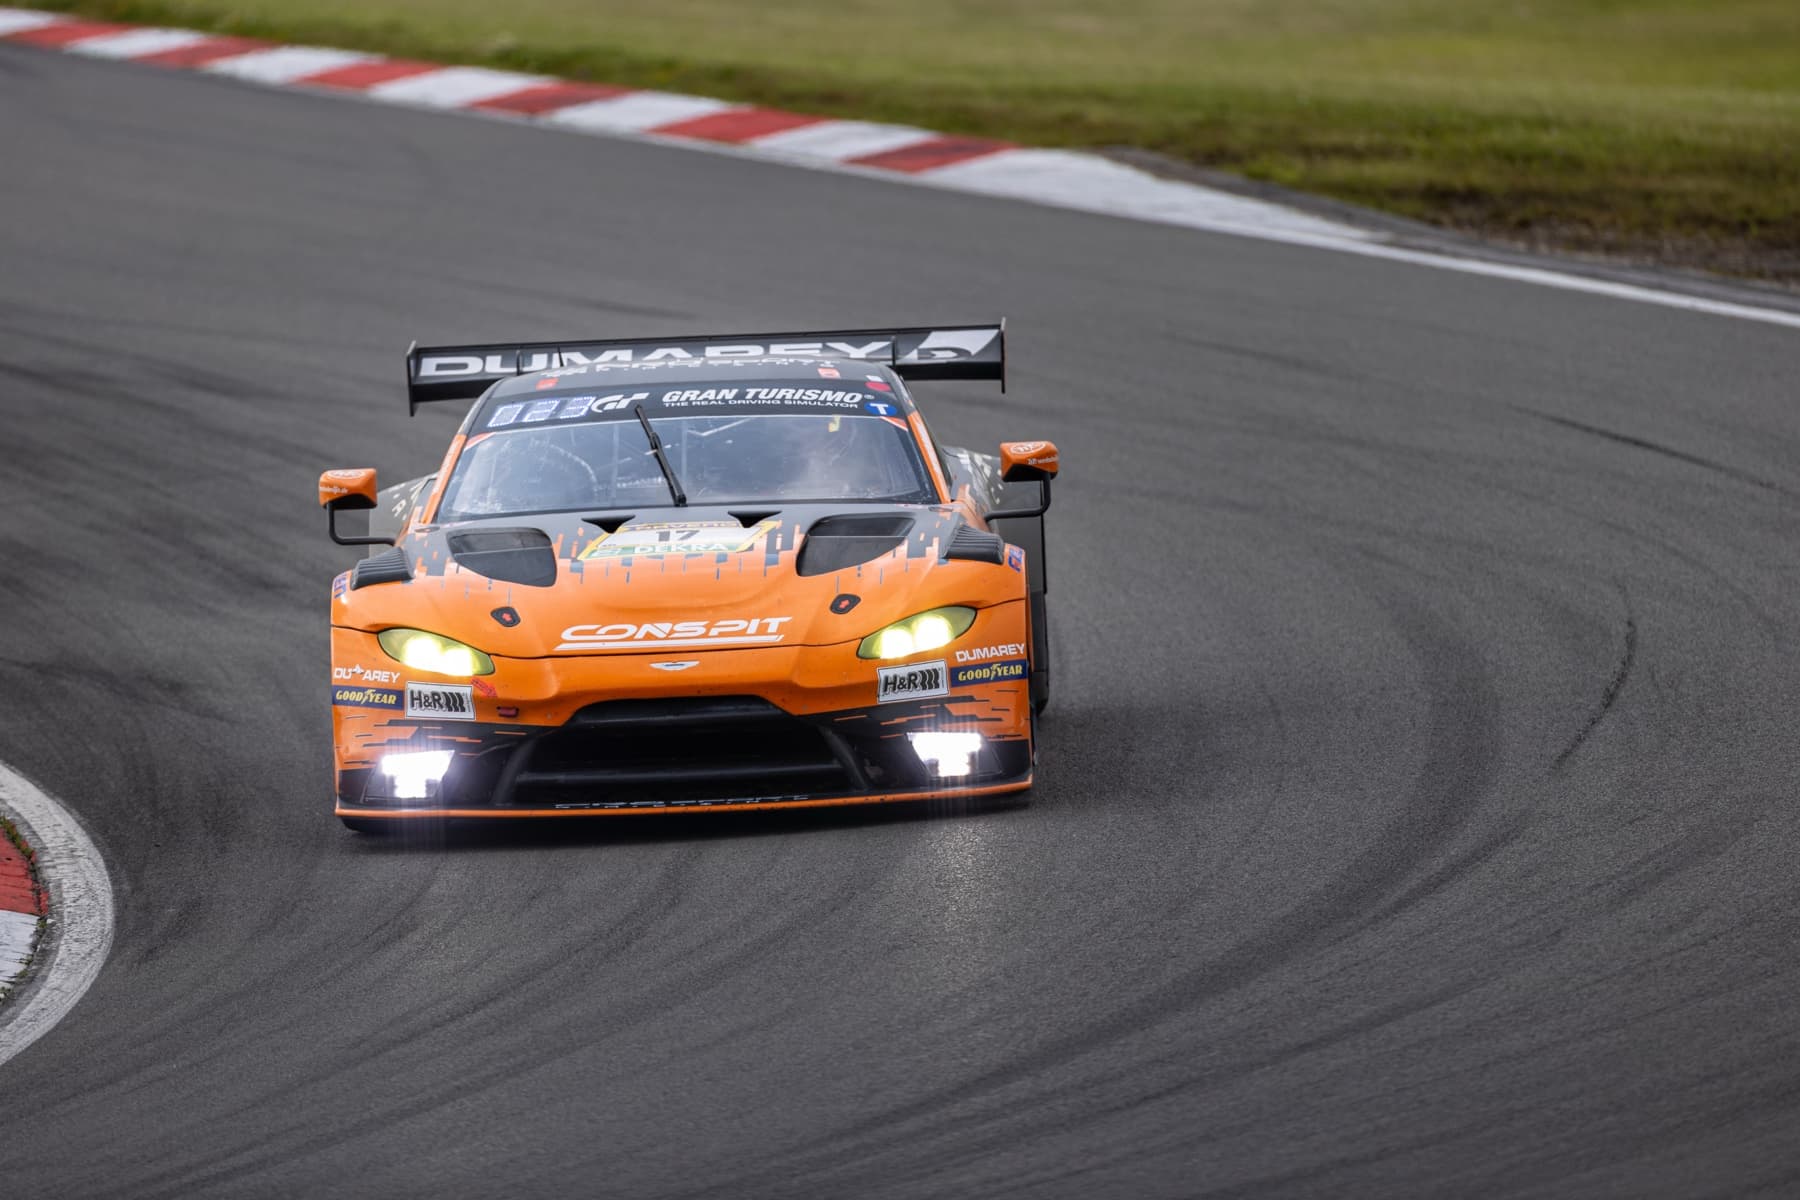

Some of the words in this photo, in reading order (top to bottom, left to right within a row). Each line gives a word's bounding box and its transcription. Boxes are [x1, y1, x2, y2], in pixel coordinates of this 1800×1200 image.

[662, 388, 739, 402] GRAN
[783, 399, 859, 409] SIMULATOR
[656, 529, 700, 542] 17
[634, 543, 729, 554] DEKRA
[560, 616, 793, 641] CONSPIT
[955, 643, 1026, 663] DUMAREY
[333, 664, 401, 684] DUAREY
[883, 671, 919, 695] H&R
[409, 689, 443, 713] H&R
